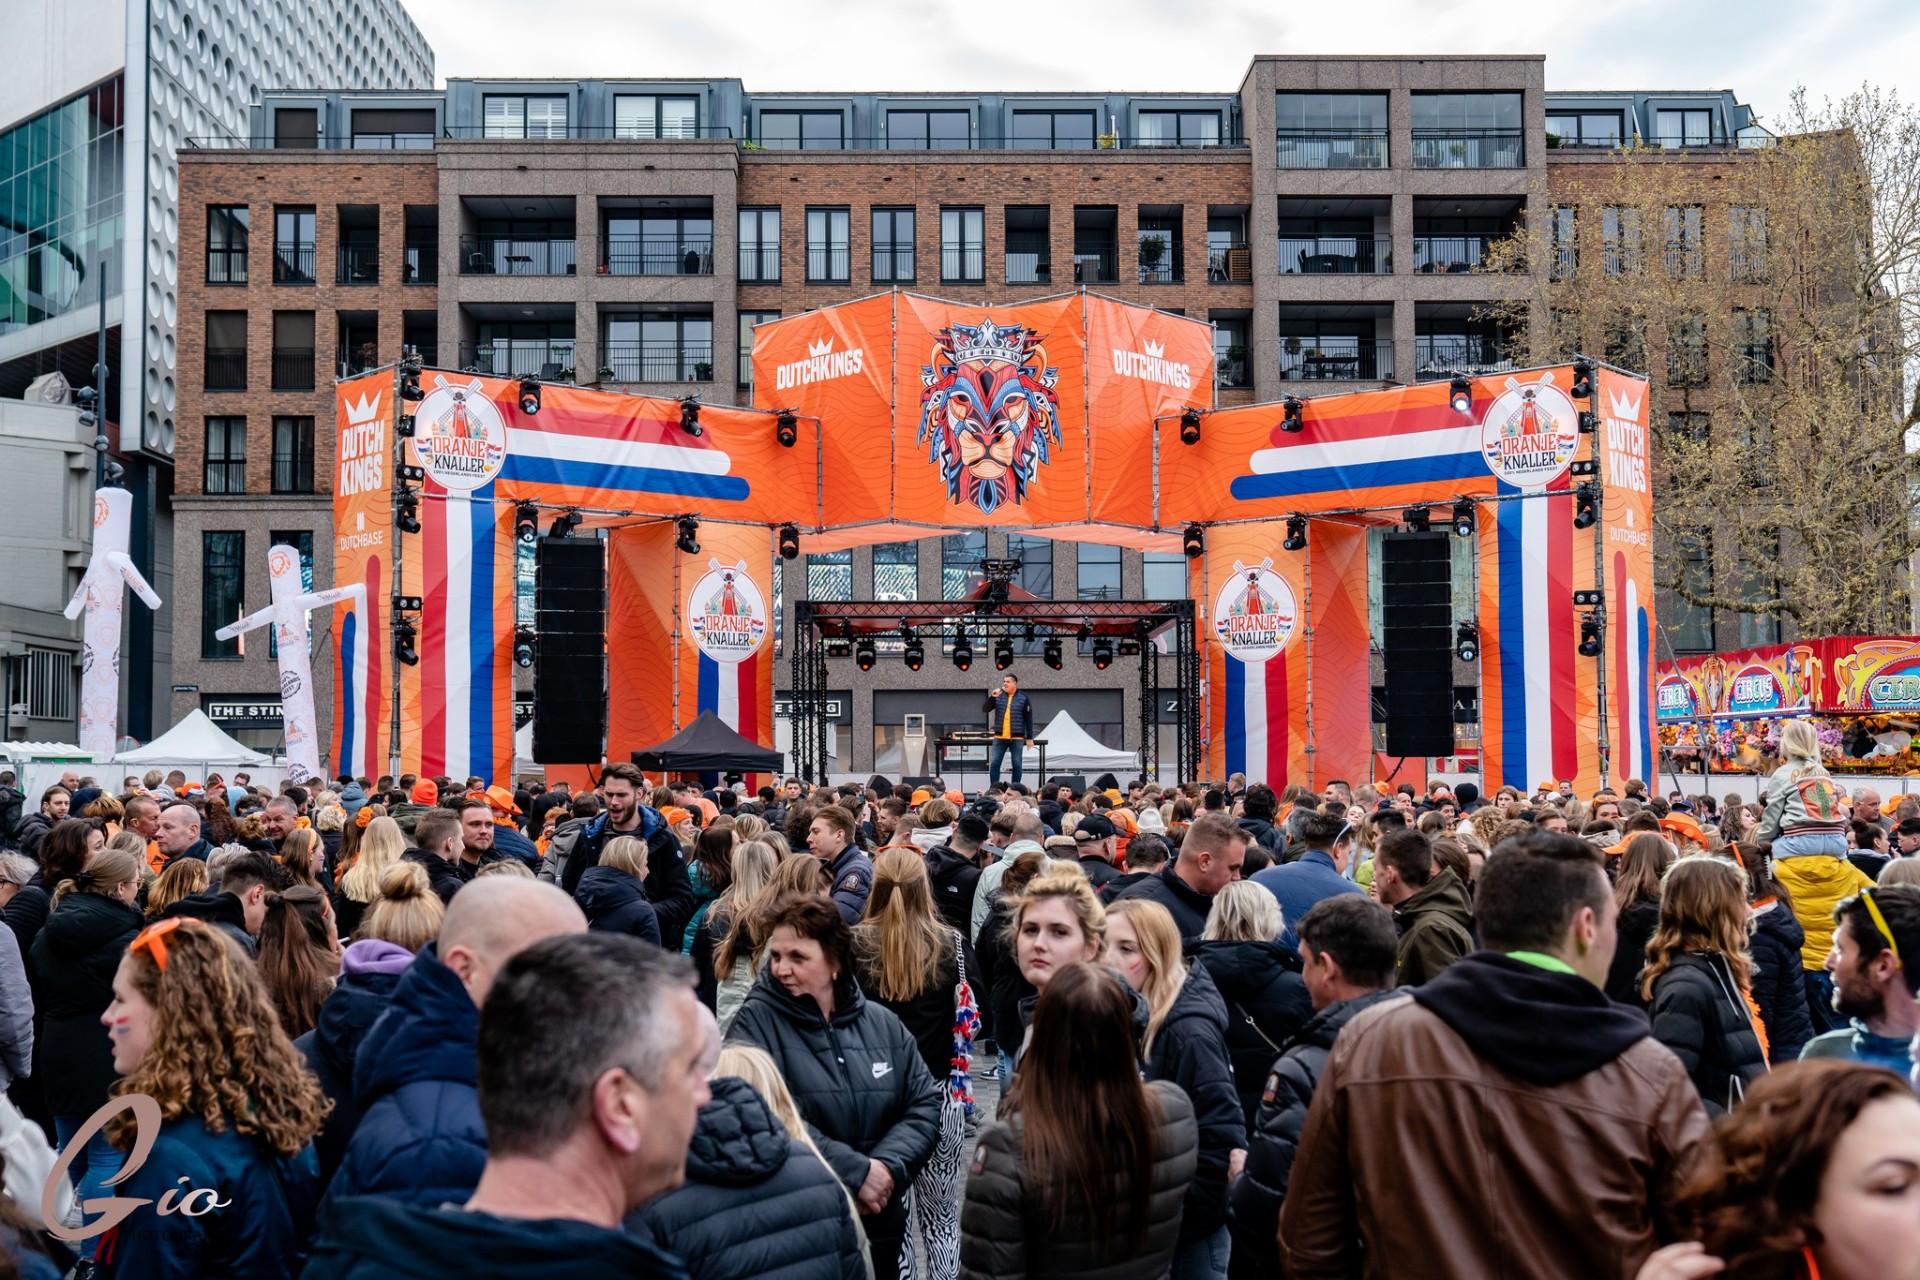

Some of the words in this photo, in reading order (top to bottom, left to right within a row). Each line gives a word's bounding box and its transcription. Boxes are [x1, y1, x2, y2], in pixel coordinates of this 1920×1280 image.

[776, 348, 864, 391] DUTCHKINGS
[1113, 348, 1191, 389] DUTCHKINGS
[341, 419, 385, 461] DUTCH
[433, 436, 486, 458] ORANJE
[1502, 433, 1557, 455] ORANJE
[1606, 417, 1644, 458] DUTCH
[434, 454, 485, 473] KNALLER
[1503, 451, 1557, 470] KNALLER
[340, 453, 384, 497] KINGS
[1609, 450, 1647, 494] KINGS
[340, 530, 384, 551] DUTCHBASE
[1610, 527, 1648, 546] DUTCHBASE
[706, 615, 750, 632] ORANJE
[1230, 614, 1277, 632] ORANJE
[706, 631, 750, 646] KNALLER
[1231, 630, 1276, 646] KNALLER
[1734, 675, 1774, 703] CIRCUS
[1869, 675, 1920, 701] CIR
[213, 706, 244, 716] THE
[248, 706, 284, 716] STIN
